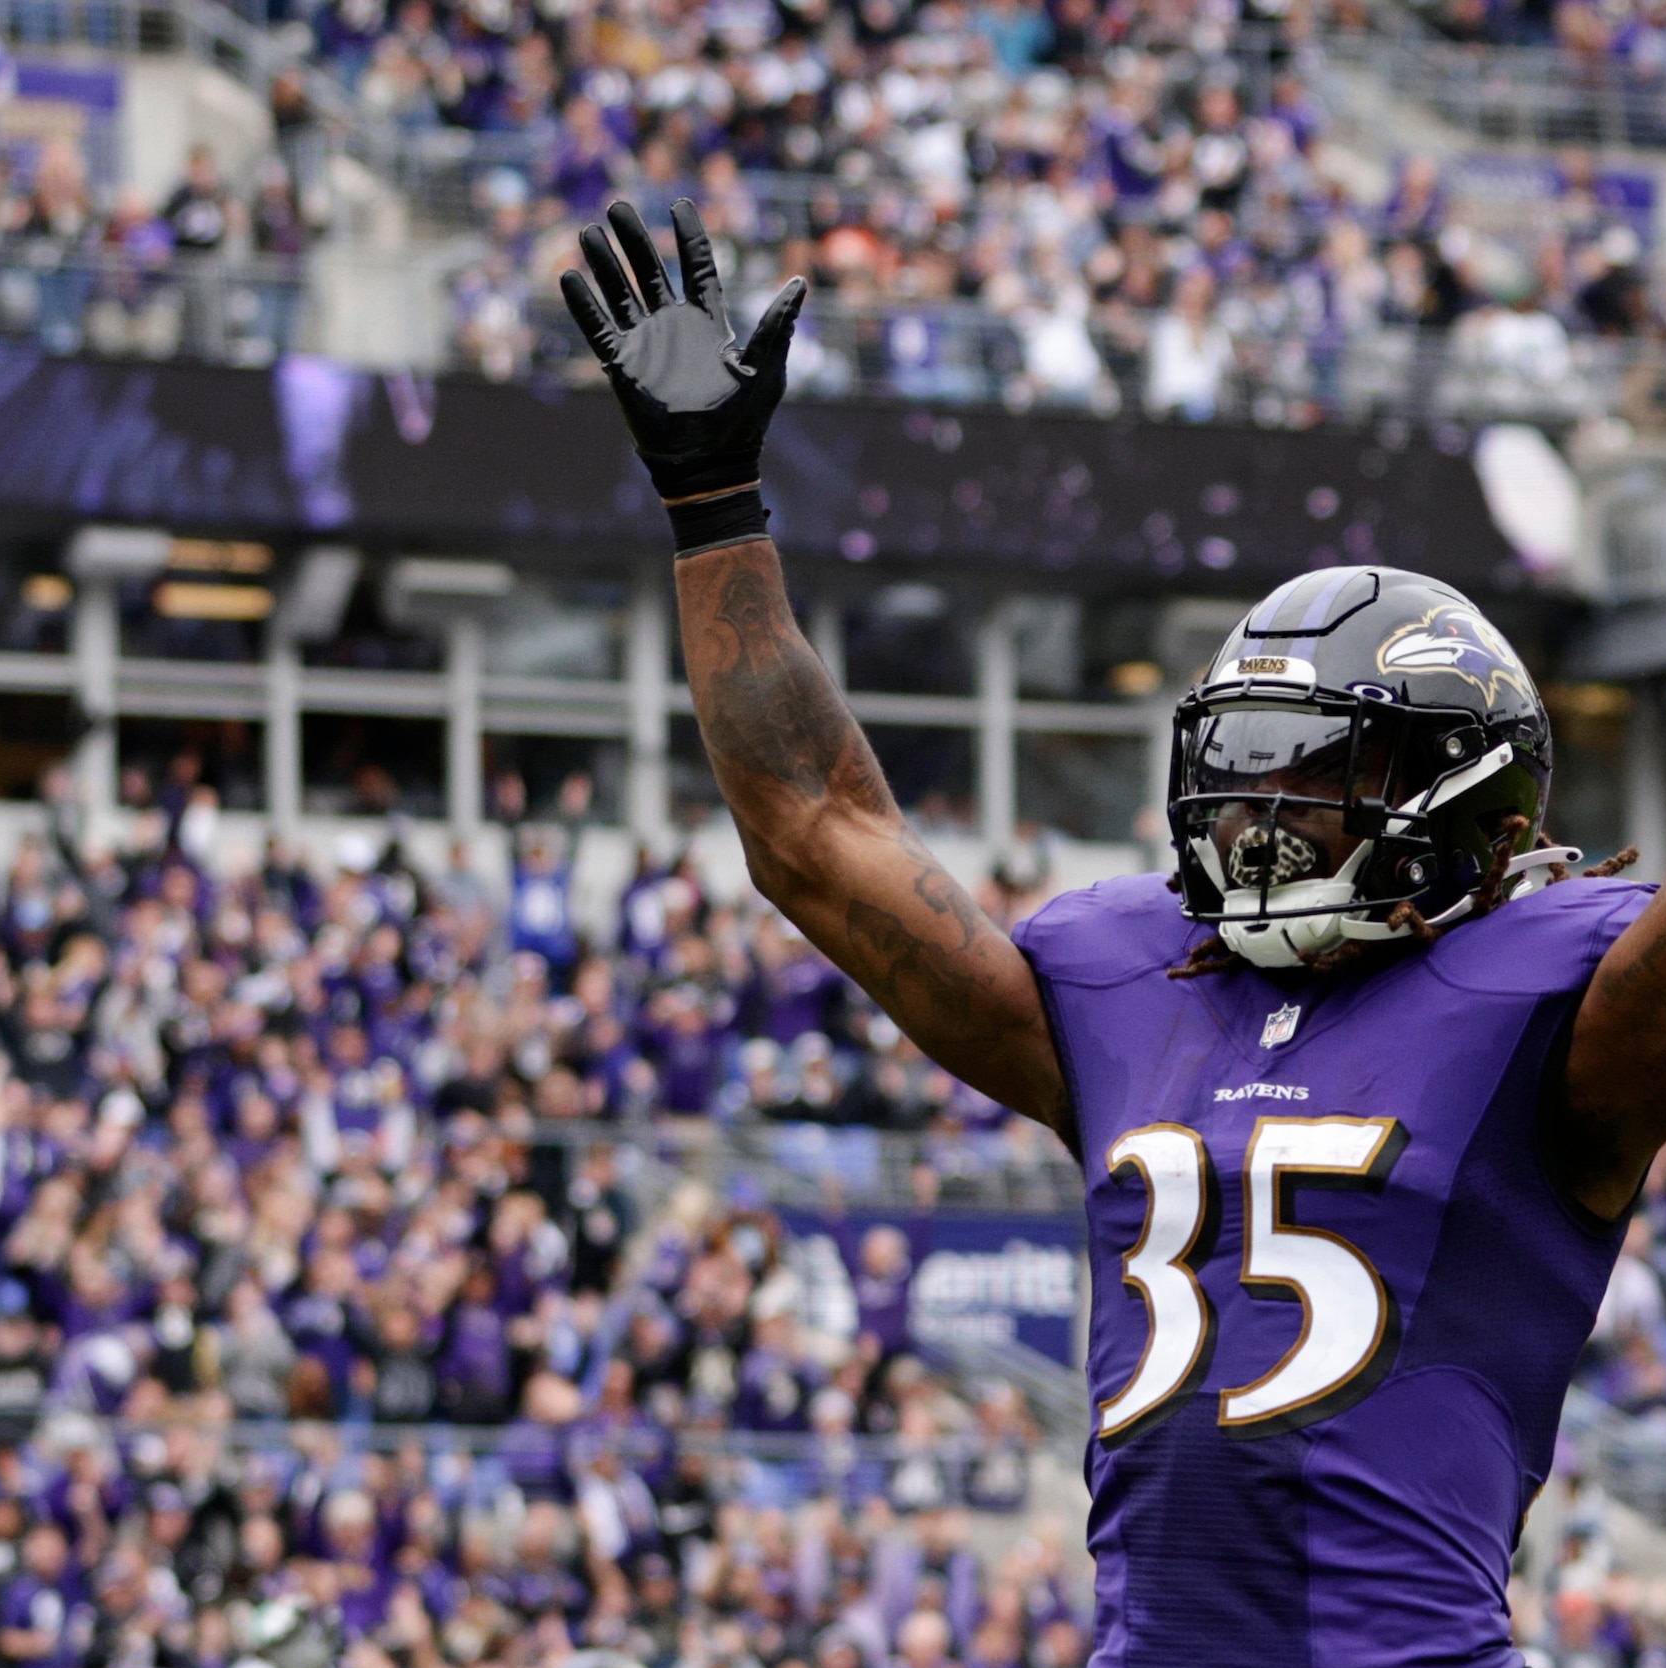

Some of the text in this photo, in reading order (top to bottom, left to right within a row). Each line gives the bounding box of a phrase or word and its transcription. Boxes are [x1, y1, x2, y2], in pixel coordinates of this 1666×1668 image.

[1238, 658, 1288, 674] RAVENS
[1213, 1083, 1310, 1102] RAVENS
[910, 1238, 1078, 1316] erritt
[1098, 1115, 1411, 1452] 35
